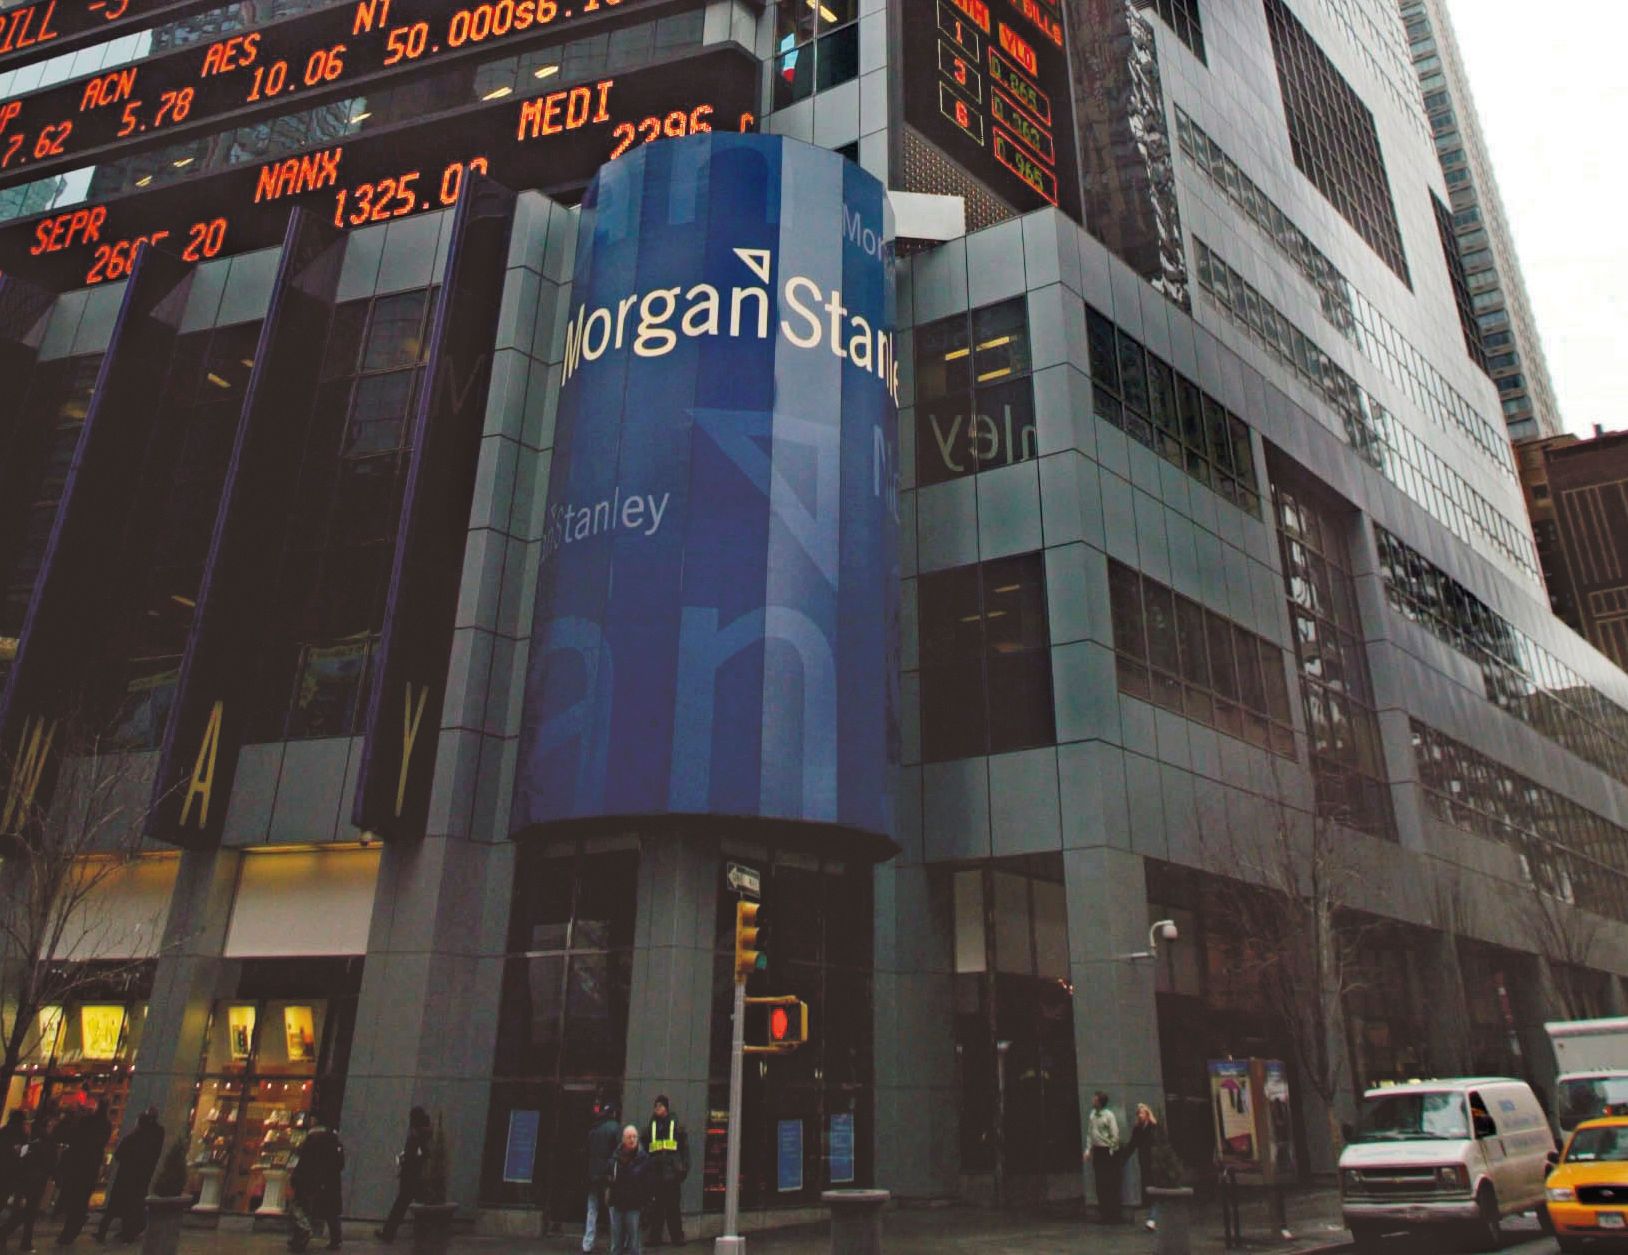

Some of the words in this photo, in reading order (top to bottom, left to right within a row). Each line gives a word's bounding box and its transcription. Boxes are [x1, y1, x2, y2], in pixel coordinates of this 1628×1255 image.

[201, 33, 262, 78] AES
[247, 45, 347, 102] 10.06
[80, 67, 138, 111] ACN
[117, 87, 195, 137] 5.78
[517, 80, 614, 141] MEDI
[1, 121, 73, 167] 7.62
[254, 148, 343, 203] NANX
[30, 207, 107, 255] SEPR
[561, 283, 769, 386] Morgan
